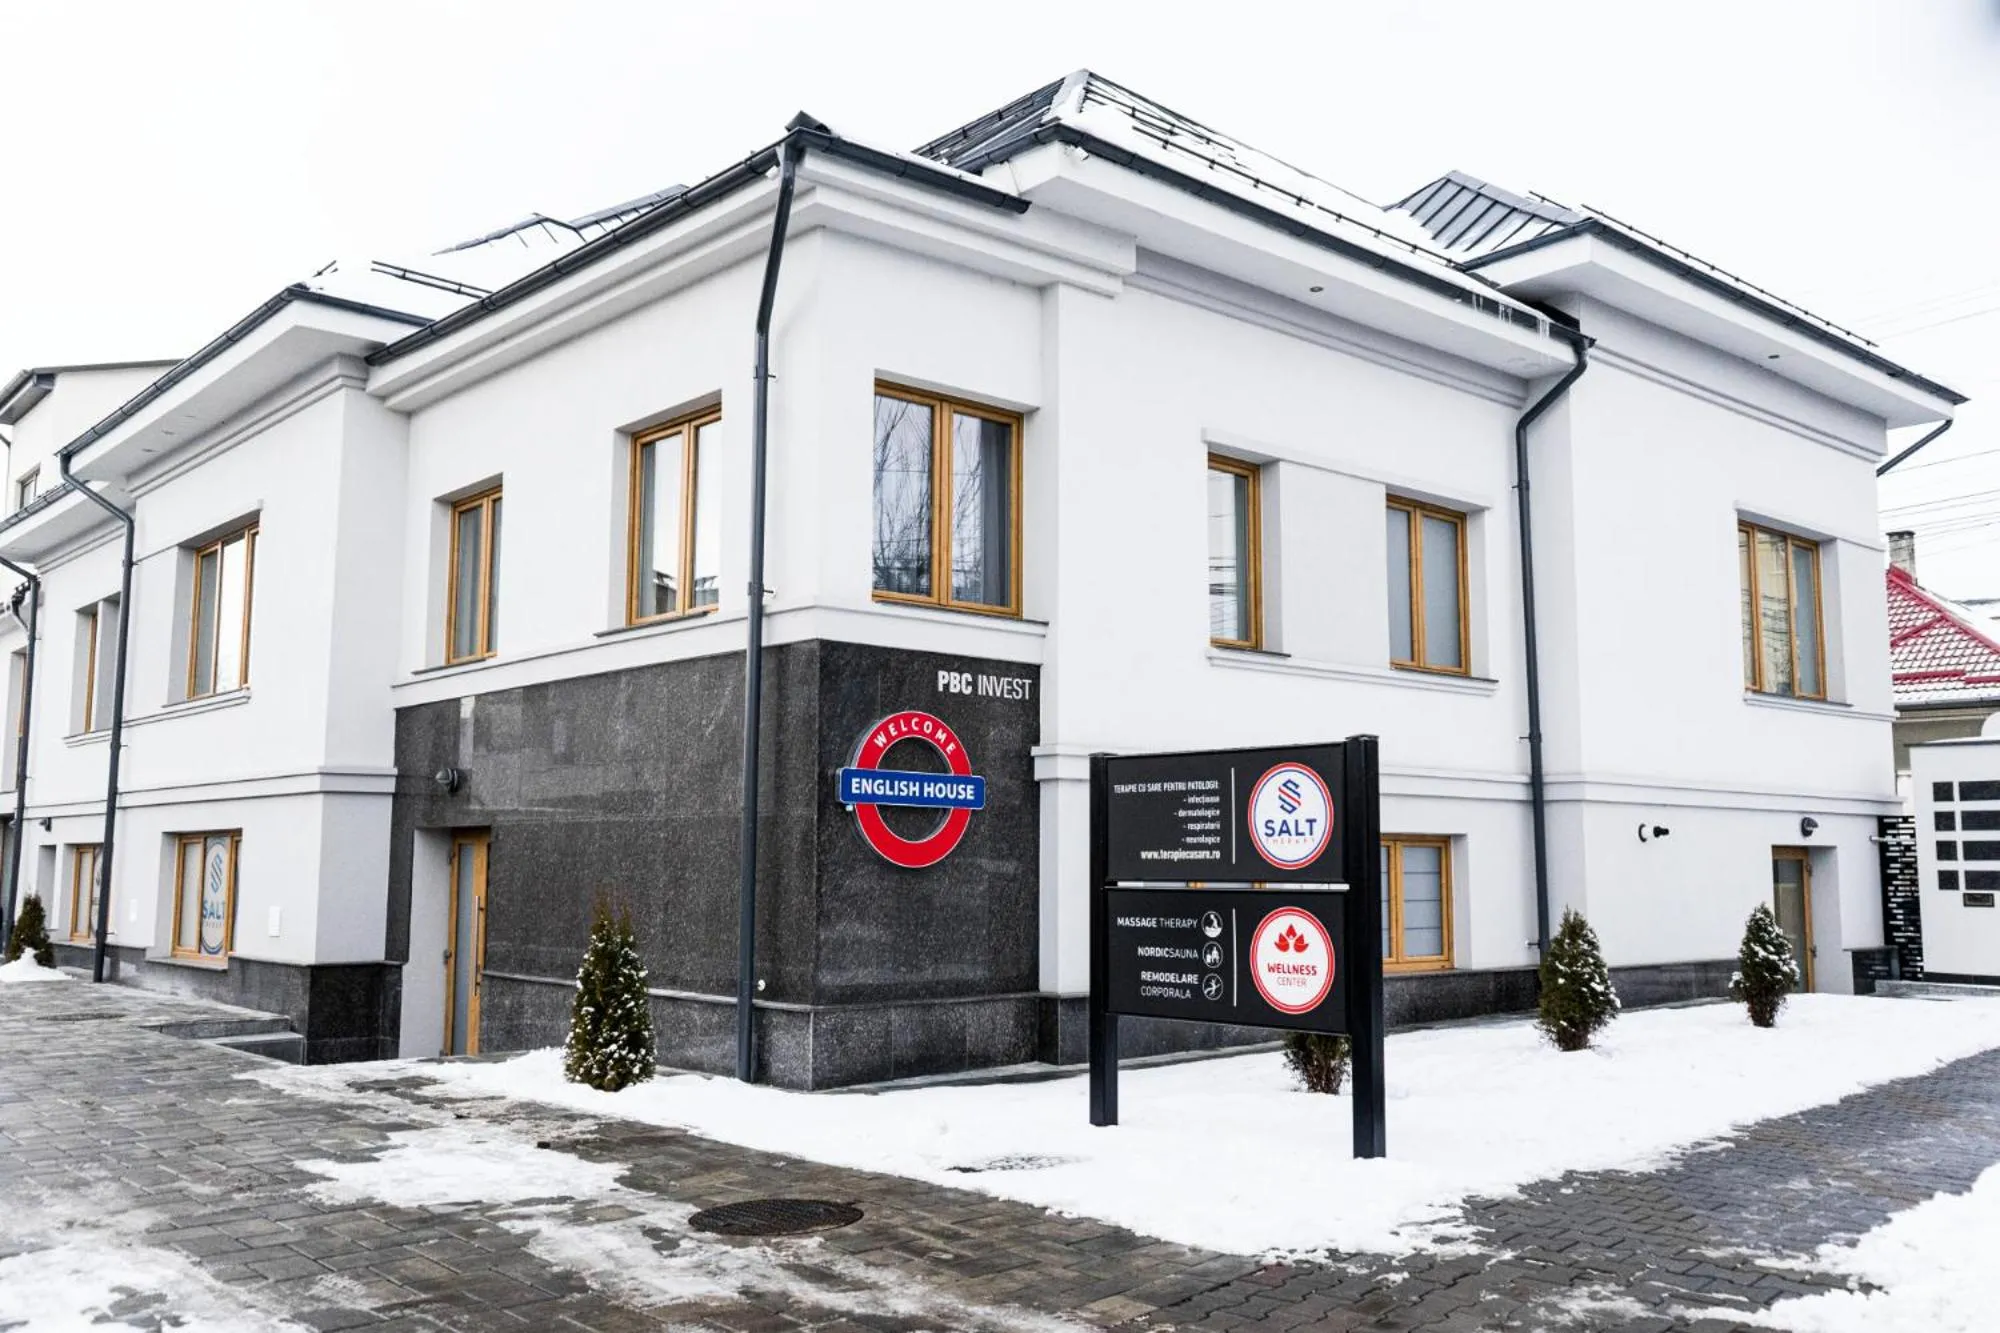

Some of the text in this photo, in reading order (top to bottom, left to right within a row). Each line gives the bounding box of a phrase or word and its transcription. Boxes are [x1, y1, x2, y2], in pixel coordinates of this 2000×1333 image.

[937, 670, 1033, 700] PBC INVEST
[873, 717, 957, 755] WELCOME
[851, 778, 975, 800] ENGLISH HOUSE
[1114, 783, 1138, 793] TERAPIE
[1138, 783, 1146, 793] CU
[1147, 782, 1162, 792] SARE
[1163, 781, 1187, 792] PENTRU
[1264, 818, 1318, 837] SALT
[1116, 917, 1198, 928] MASSAGE THERAPY
[1137, 945, 1199, 959] NORDICSAUNA
[1267, 962, 1318, 976] WELLNESS
[1140, 970, 1200, 985] REMODELARE
[1276, 976, 1308, 987] CENTER
[1140, 986, 1192, 999] CORPORALA
